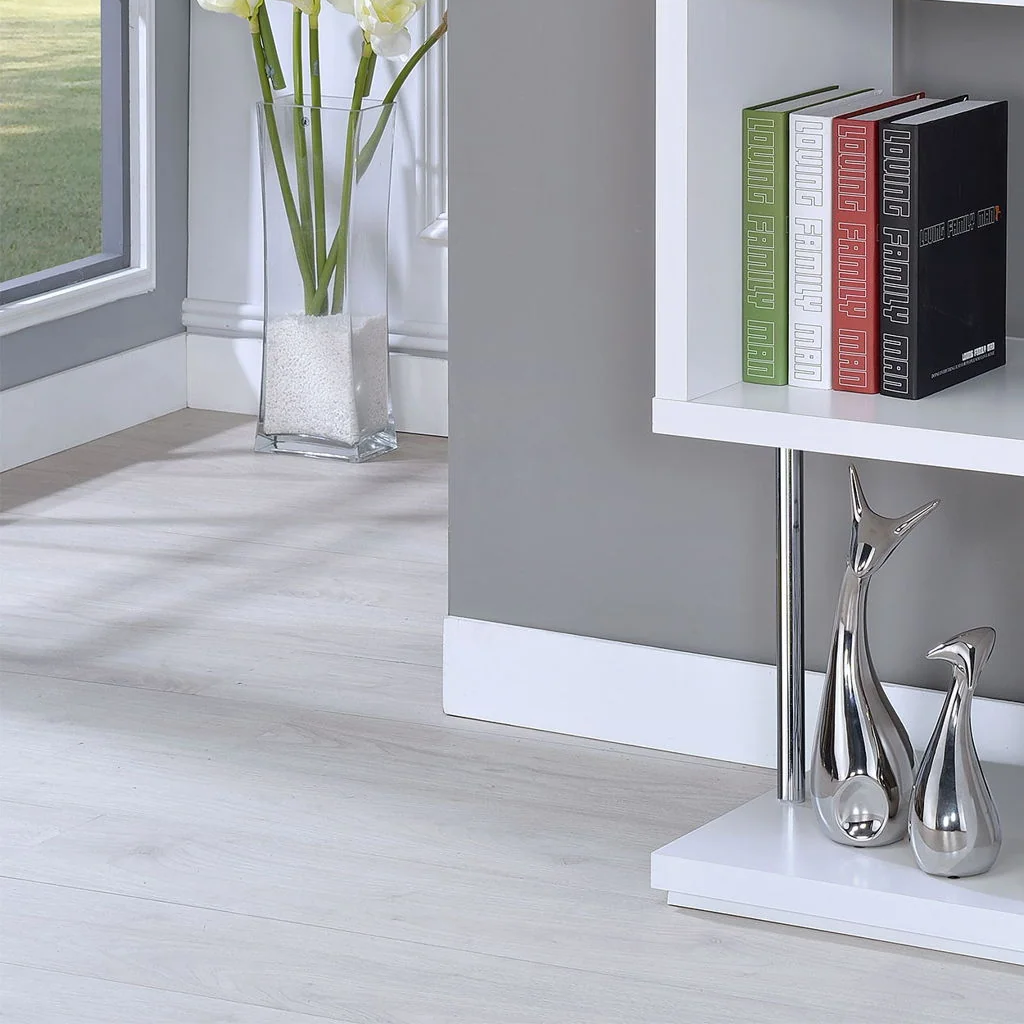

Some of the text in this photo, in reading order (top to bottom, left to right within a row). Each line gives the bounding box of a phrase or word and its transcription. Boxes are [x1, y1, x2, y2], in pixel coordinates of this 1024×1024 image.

[747, 215, 775, 310] FAMILY
[794, 217, 823, 312] FAMILY
[838, 221, 867, 319] FAMILY
[882, 227, 911, 324] FAMILY
[747, 319, 775, 378] MAN
[794, 323, 823, 383] MAN
[838, 328, 867, 388] MAN
[882, 333, 909, 394] MAN
